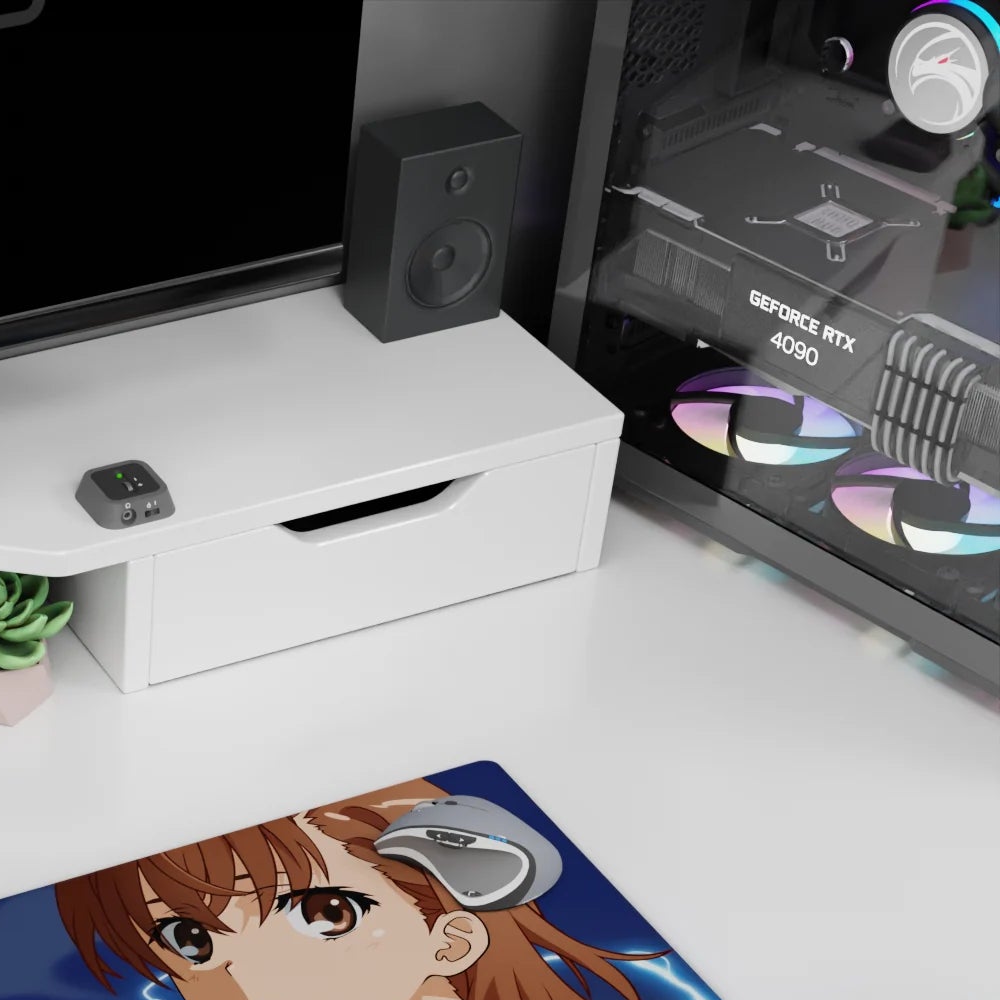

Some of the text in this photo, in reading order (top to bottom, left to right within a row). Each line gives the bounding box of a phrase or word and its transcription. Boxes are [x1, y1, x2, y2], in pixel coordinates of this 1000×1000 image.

[749, 289, 856, 354] GEFORCE RTX
[770, 332, 819, 366] 4090
